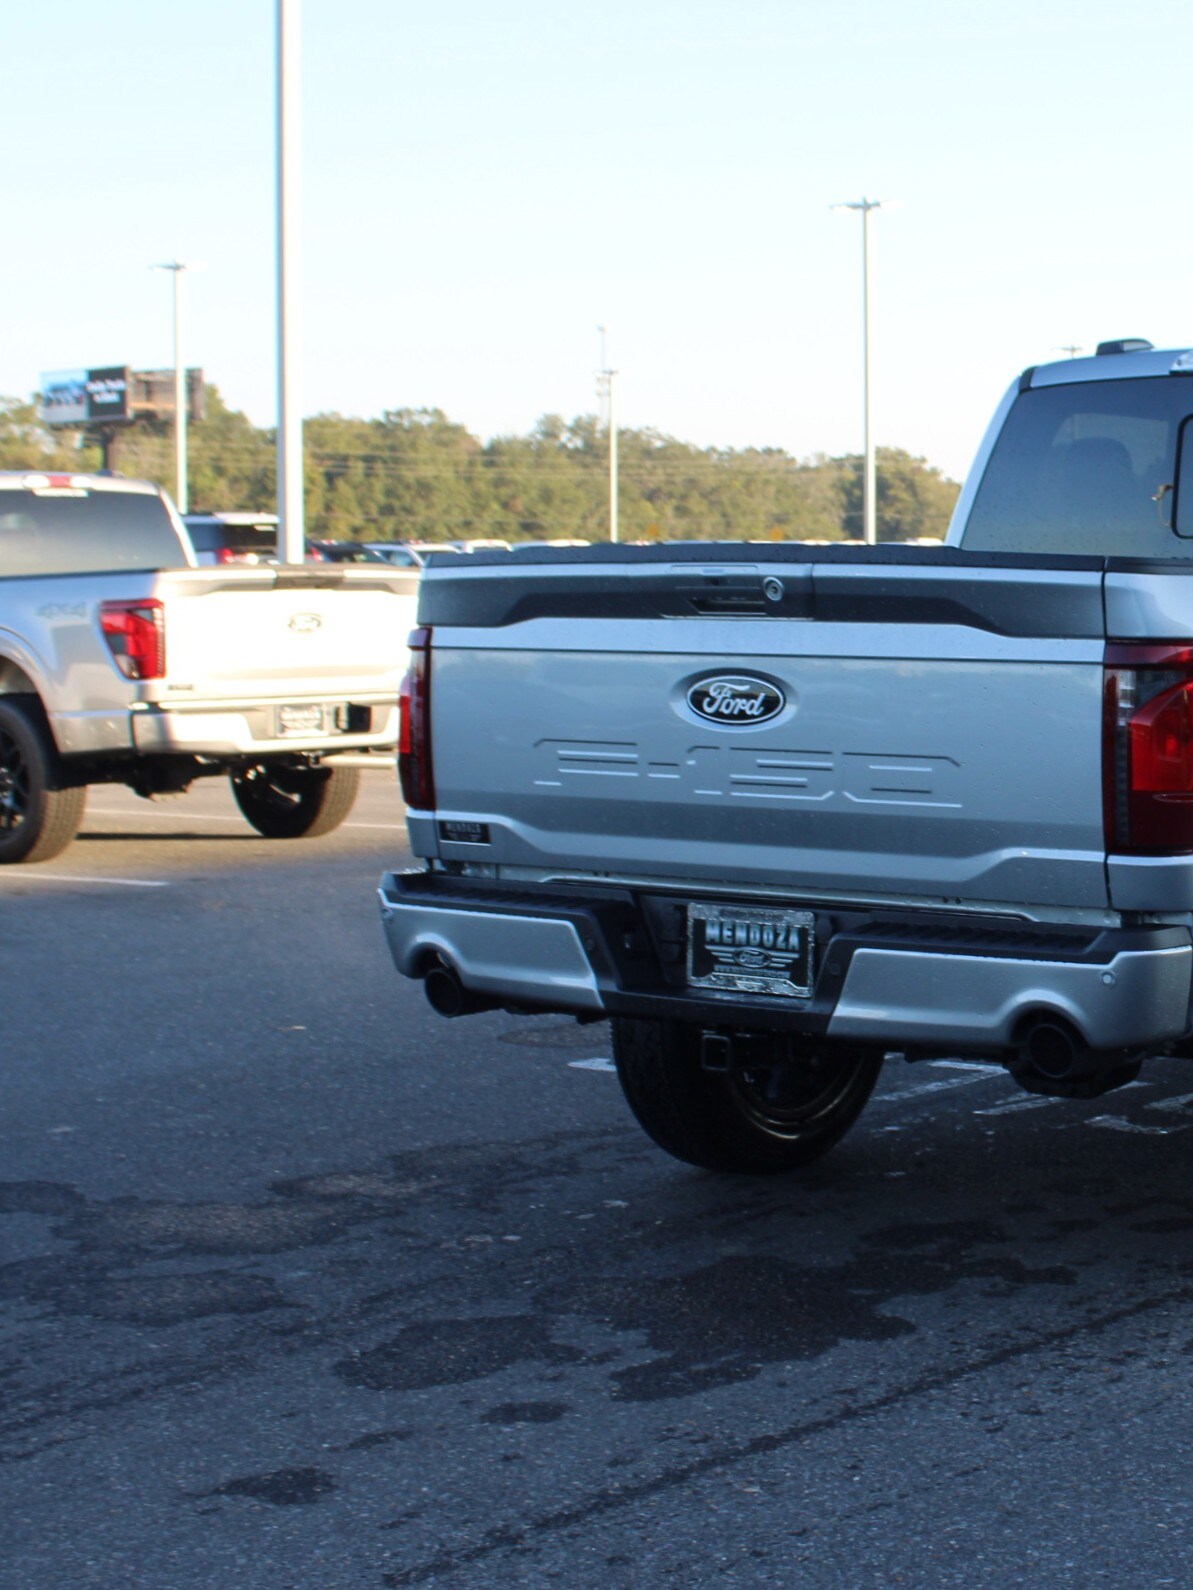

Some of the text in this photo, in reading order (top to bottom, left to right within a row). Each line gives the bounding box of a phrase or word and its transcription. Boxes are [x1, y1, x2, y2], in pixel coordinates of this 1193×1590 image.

[702, 682, 766, 716] Ford
[533, 738, 962, 808] F-150
[705, 921, 800, 950] MENDOZA
